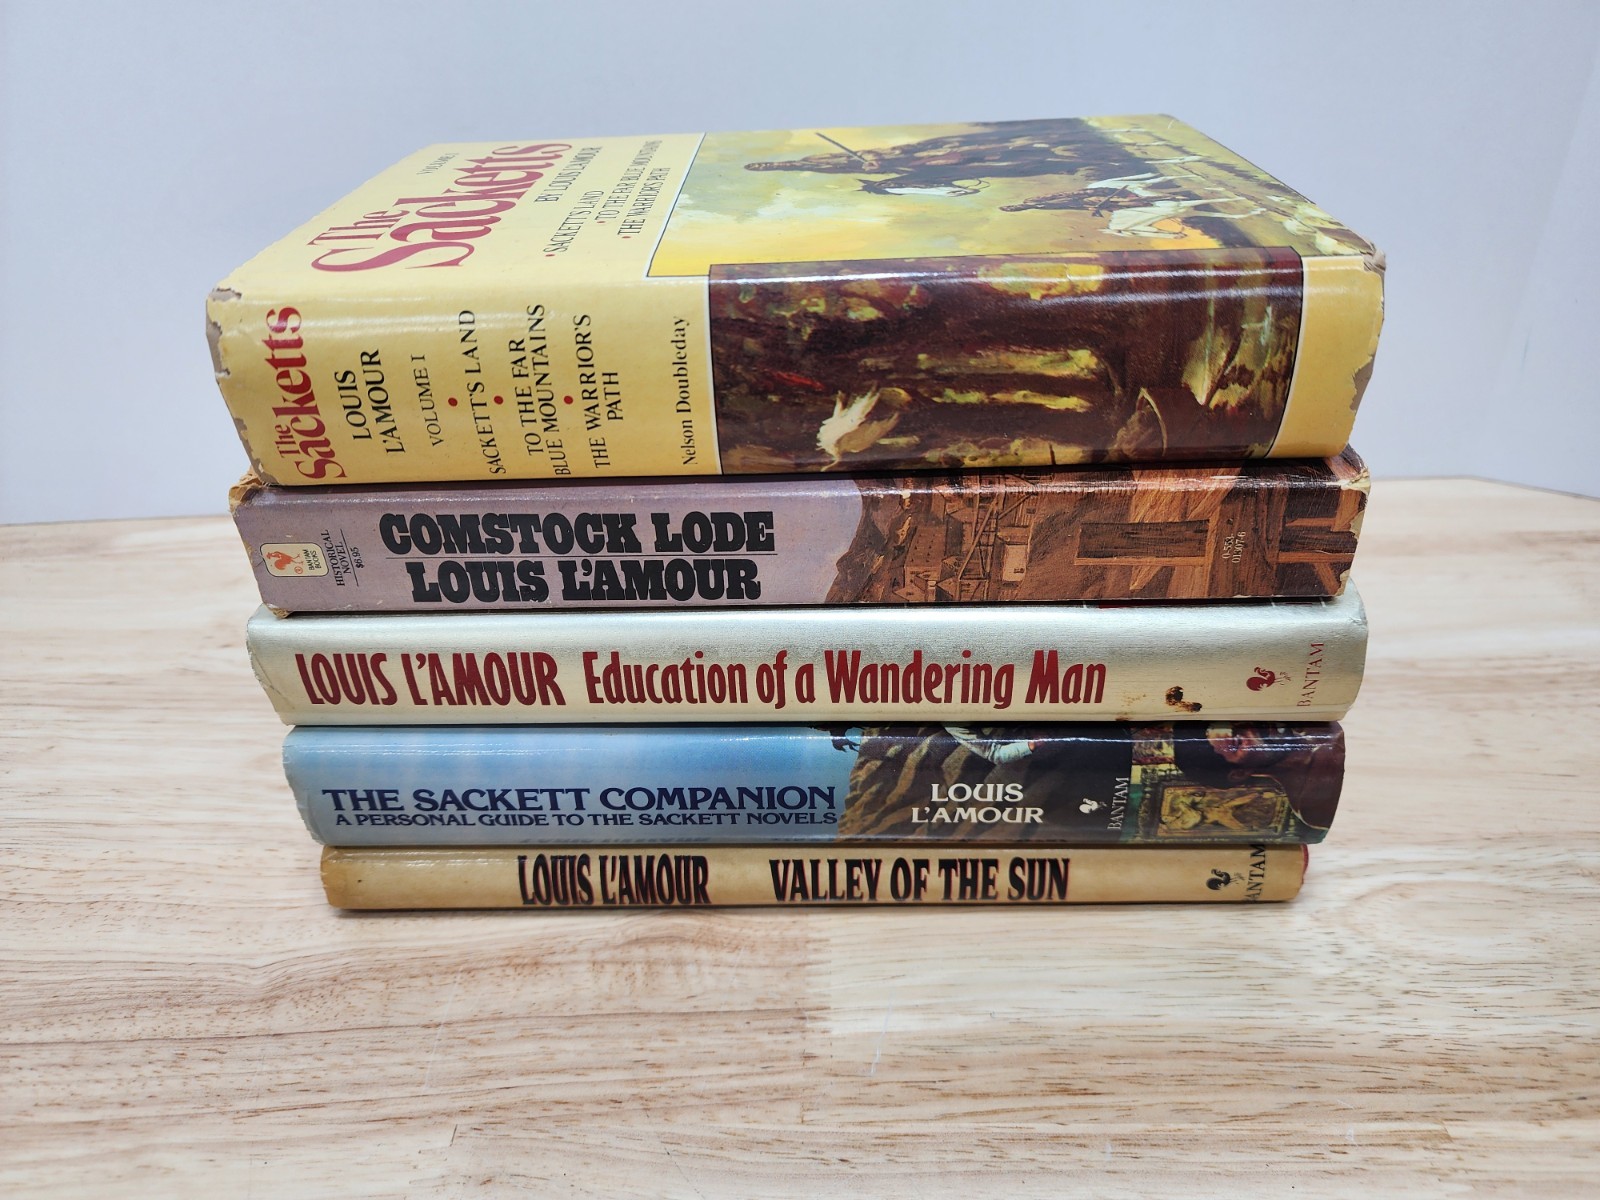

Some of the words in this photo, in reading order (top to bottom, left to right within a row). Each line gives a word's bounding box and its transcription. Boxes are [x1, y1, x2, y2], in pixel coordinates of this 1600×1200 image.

[543, 171, 582, 192] LOUIS
[612, 182, 637, 194] FAR
[620, 167, 646, 181] BLUE
[311, 143, 573, 273] Sacketts
[533, 193, 563, 203] BY
[595, 209, 620, 221] TO
[602, 194, 629, 209] THE
[617, 219, 646, 235] THE
[646, 167, 671, 181] PATH
[307, 210, 410, 246] The
[543, 210, 592, 253] SACKETT'S
[573, 190, 605, 209] LAND
[458, 309, 482, 375] LAND
[508, 338, 530, 379] FAR
[526, 304, 560, 433] MOUNTAINS
[573, 314, 602, 431] WARRIOR'S
[670, 316, 692, 414] Doubleday
[262, 306, 347, 479] Sacketts
[334, 369, 372, 440] LOUIS
[360, 349, 406, 454] L'AMOUR
[413, 367, 444, 447] VOLUME
[515, 385, 538, 428] THE
[602, 371, 624, 421] PATH
[274, 424, 300, 458] The
[466, 381, 506, 475] SACKETT'S
[523, 432, 544, 456] TO
[680, 419, 699, 466] Nelson
[546, 438, 572, 476] BLUE
[589, 437, 611, 469] THE
[379, 511, 642, 555] COMSTOCK
[651, 510, 776, 554] LODE
[302, 549, 315, 571] BANTAM
[321, 529, 346, 587] HISTORICAL
[335, 541, 352, 574] NOVEL
[350, 547, 365, 569] $6.95
[405, 560, 550, 603] LOUIS
[558, 558, 762, 602] L'AMOUR
[295, 652, 398, 706] LOUIS
[401, 652, 567, 706] L'AMOUR
[582, 650, 748, 705] Education
[756, 650, 788, 710] of
[795, 663, 815, 704] a
[824, 649, 1015, 710] Wandering
[1024, 649, 1107, 704] Man
[1296, 642, 1325, 707] BANTAM
[321, 788, 405, 812] THE
[412, 788, 591, 812] SACKETT
[599, 785, 836, 811] COMPANION
[911, 806, 1045, 824] L'AMOUR
[930, 783, 1024, 802] LOUIS
[1107, 776, 1130, 831] BANTAM
[335, 814, 352, 826] A
[354, 813, 476, 827] PERSONAL
[478, 813, 550, 826] GUIDE
[551, 813, 585, 826] TO
[587, 813, 635, 826] THE
[638, 812, 741, 826] SACKETT
[746, 812, 838, 825] NOVELS
[517, 853, 595, 906] LOUIS
[598, 853, 712, 905] L'AMOUR
[768, 857, 885, 902] VALLEY
[890, 857, 931, 901] OF
[938, 857, 1000, 902] THE
[1007, 856, 1071, 901] SUN
[1244, 843, 1266, 904] ANTAM
